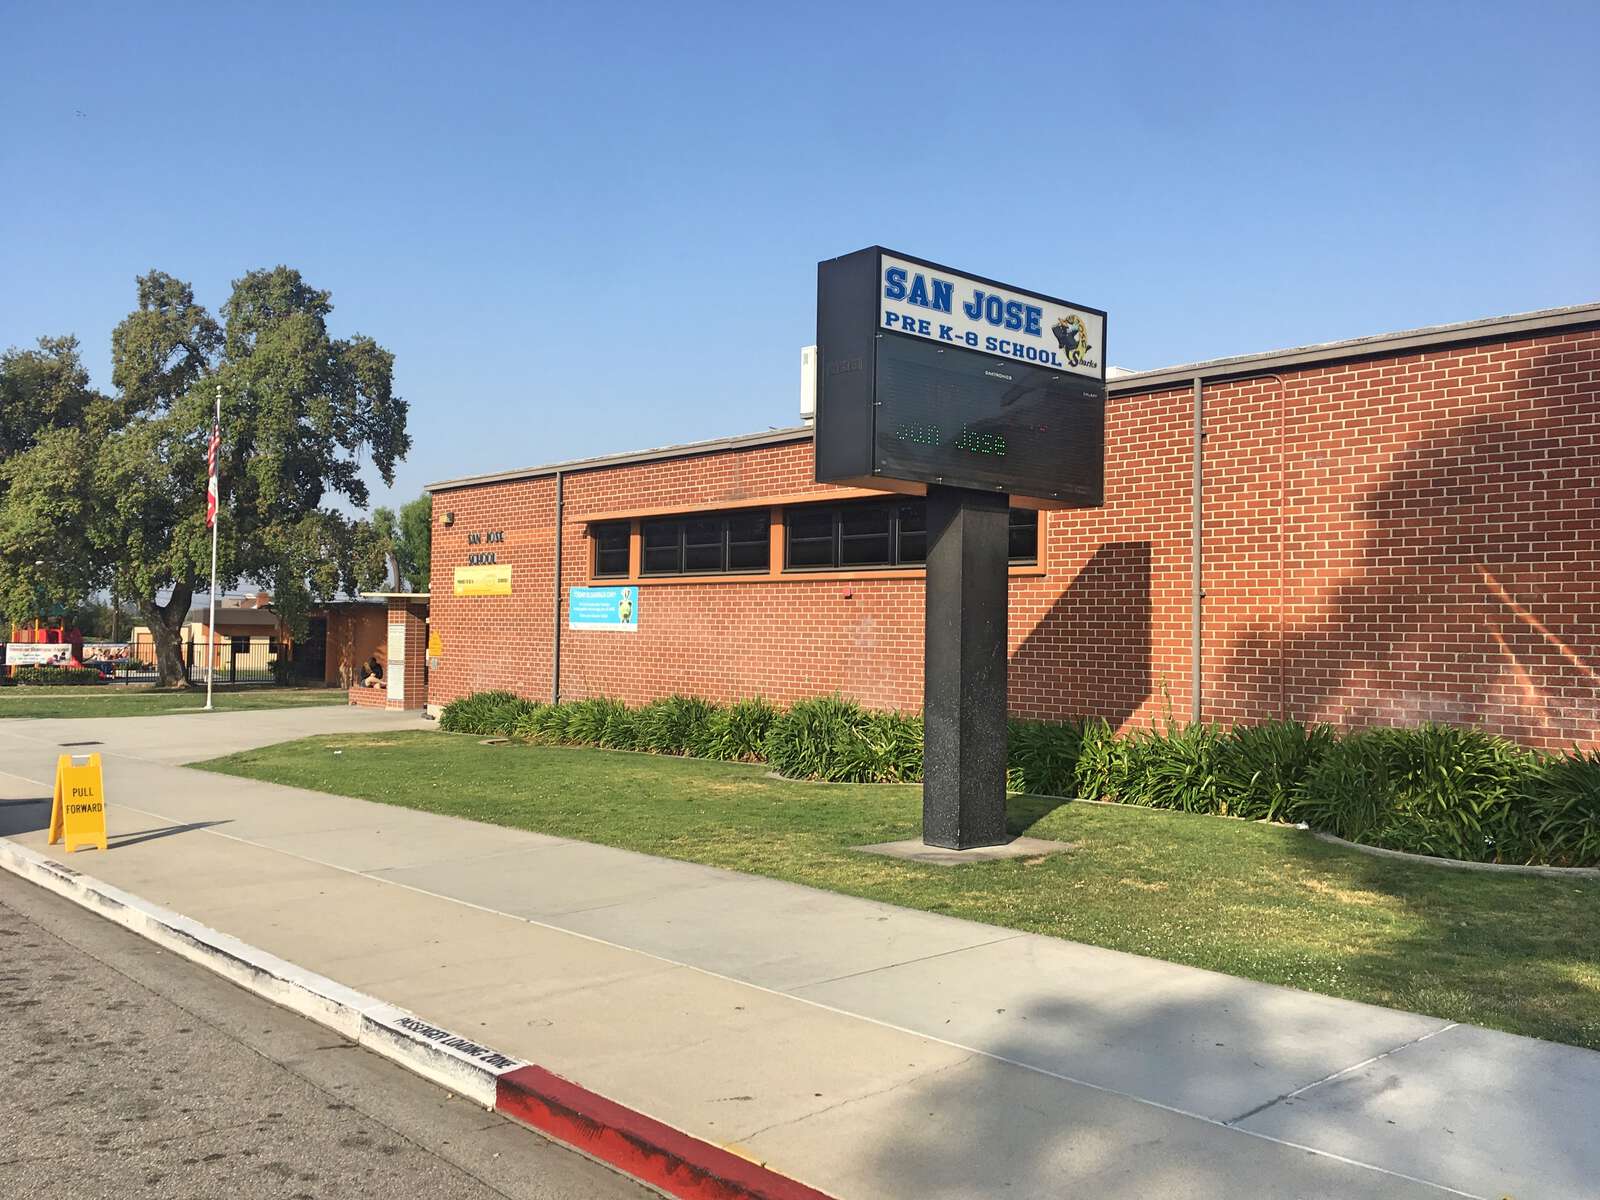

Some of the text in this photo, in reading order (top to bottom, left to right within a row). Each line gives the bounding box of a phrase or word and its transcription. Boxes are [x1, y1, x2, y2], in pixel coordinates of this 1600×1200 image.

[885, 266, 1043, 337] SAN JOSE
[885, 311, 1062, 367] PRE K-8 SCHOOL
[1068, 351, 1097, 368] Sharks
[955, 422, 1005, 456] Jose
[468, 531, 504, 545] SAN JOSE
[469, 552, 496, 566] SCHOOL
[72, 787, 94, 797] PULL
[66, 803, 103, 814] FORWARD
[480, 1053, 517, 1069] ZONE
